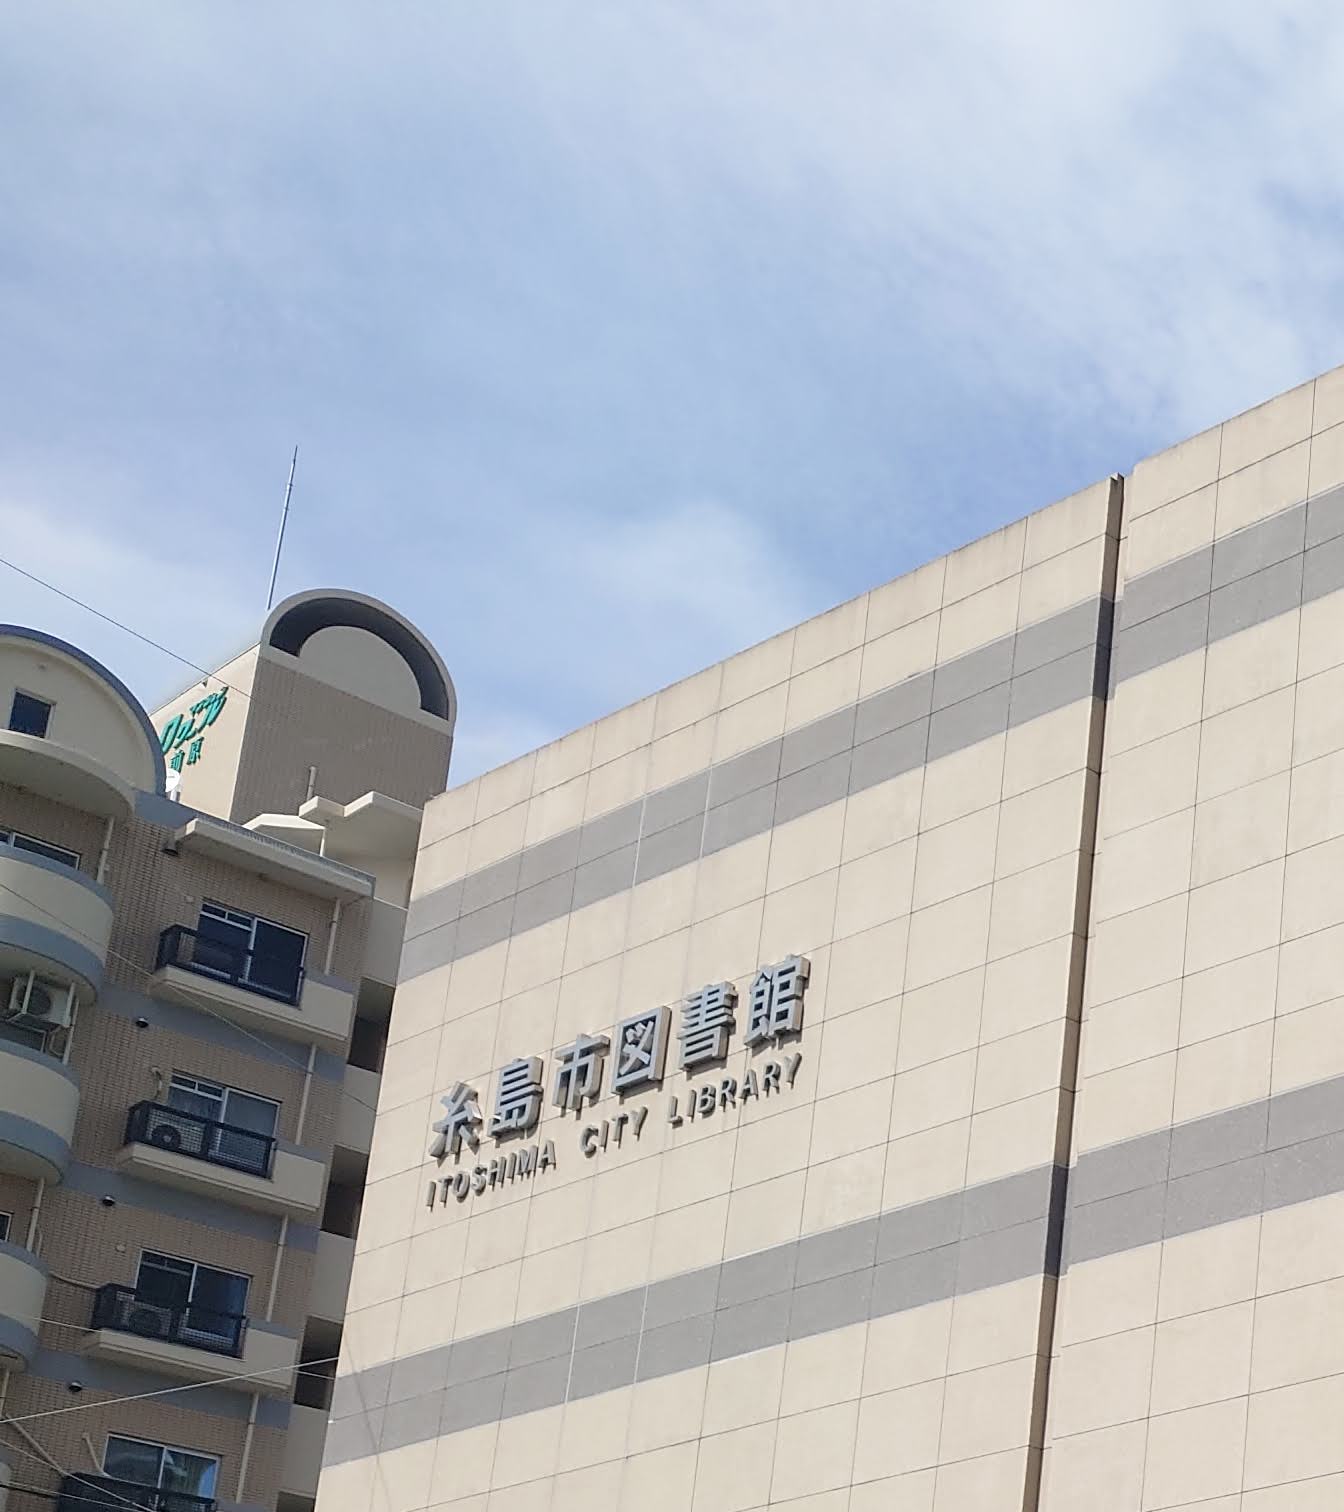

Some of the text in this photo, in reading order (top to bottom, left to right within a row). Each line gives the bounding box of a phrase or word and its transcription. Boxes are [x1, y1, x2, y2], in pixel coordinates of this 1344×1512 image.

[425, 1051, 804, 1211] ITOSHIMA CITY LIBRARY
[427, 953, 812, 1160] 糸島市図書館
